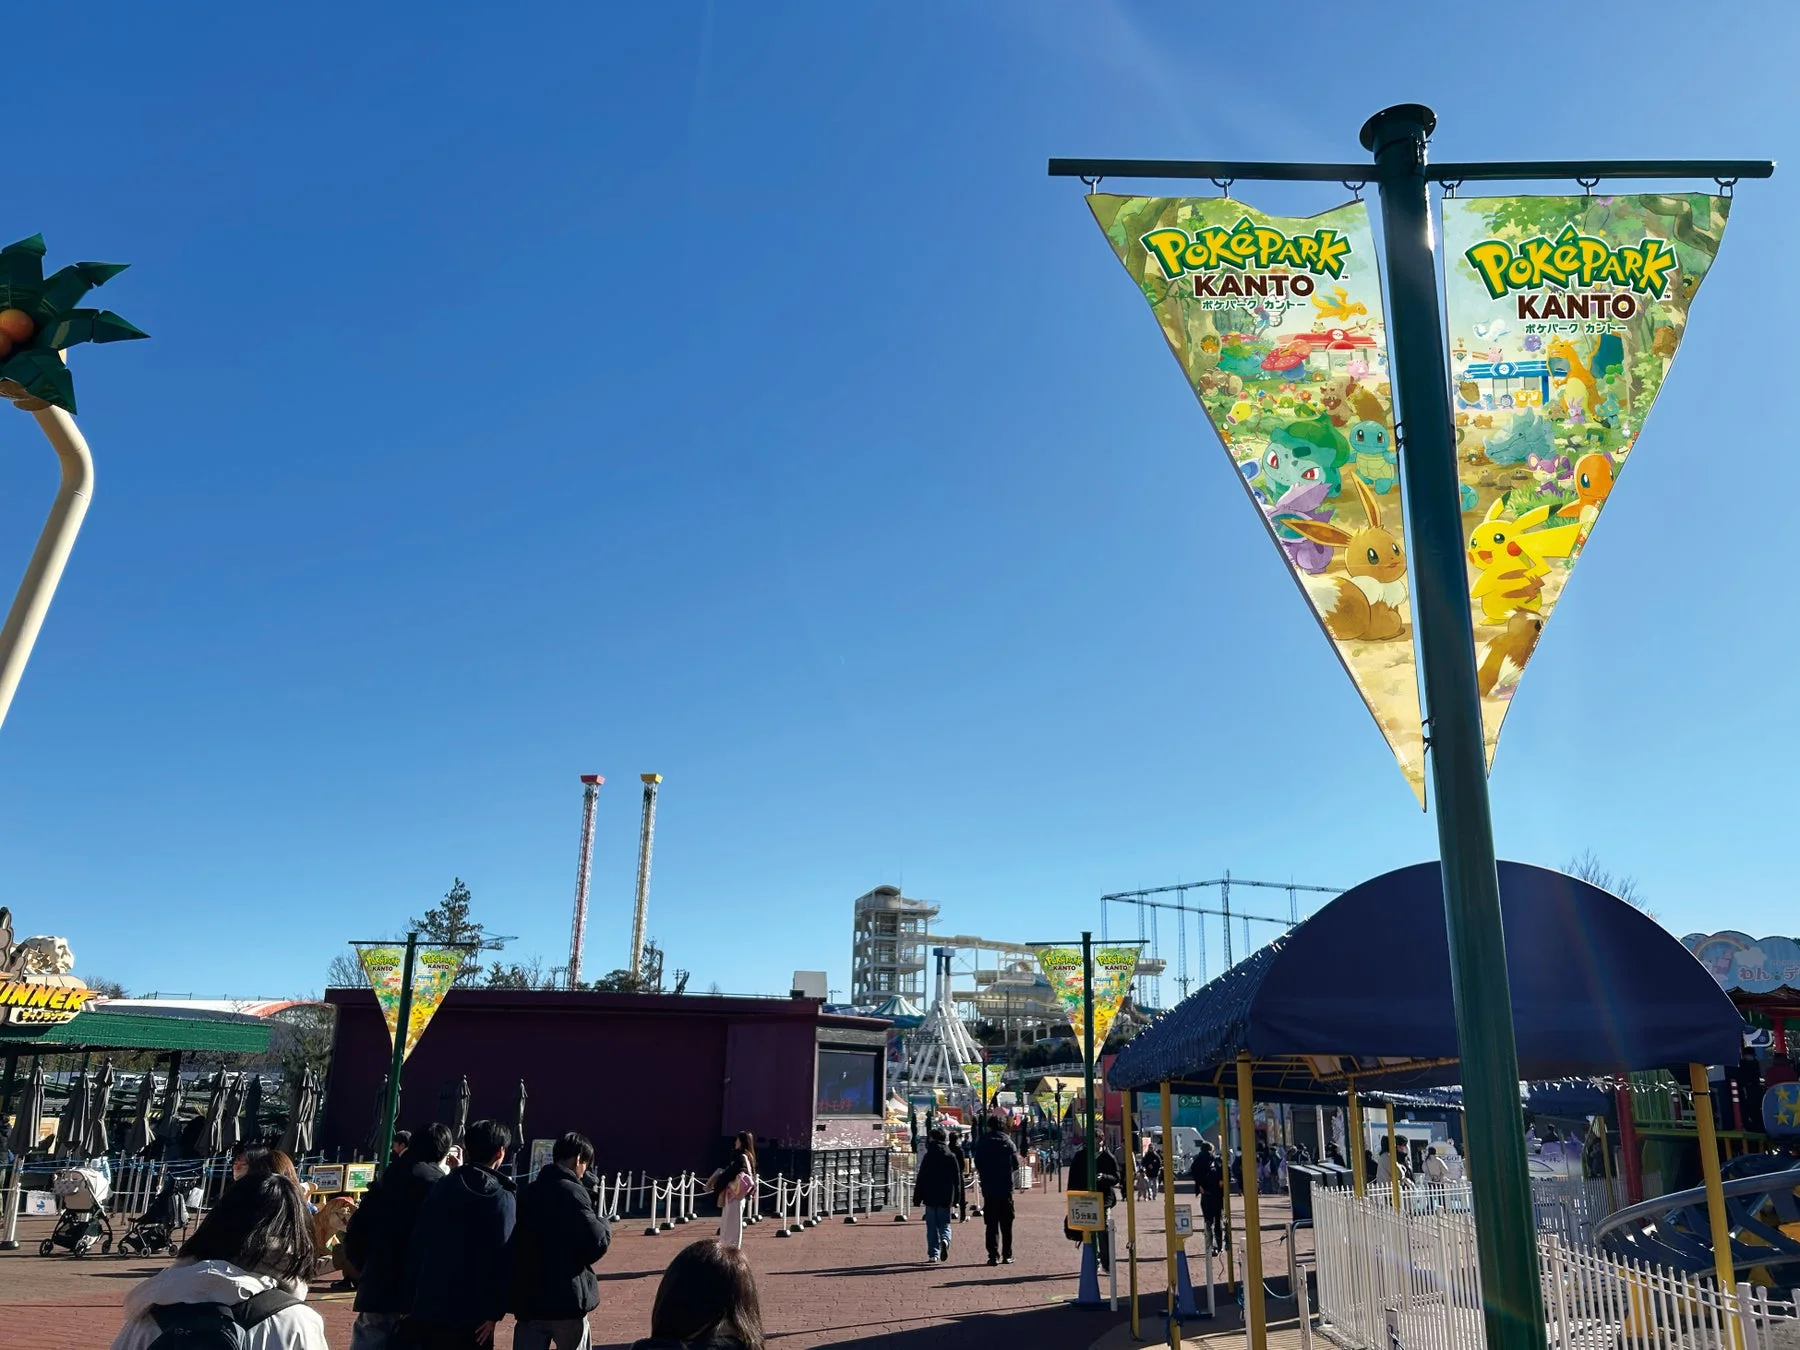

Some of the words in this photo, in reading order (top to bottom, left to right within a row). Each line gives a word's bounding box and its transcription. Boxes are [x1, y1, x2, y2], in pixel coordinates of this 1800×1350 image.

[1195, 275, 1314, 297] KANTO
[1202, 300, 1257, 310] ポケパーク
[1265, 300, 1306, 309] カントー
[1518, 295, 1636, 319] KANTO
[1525, 323, 1578, 334] ポケパーク
[1585, 324, 1627, 333] カントー
